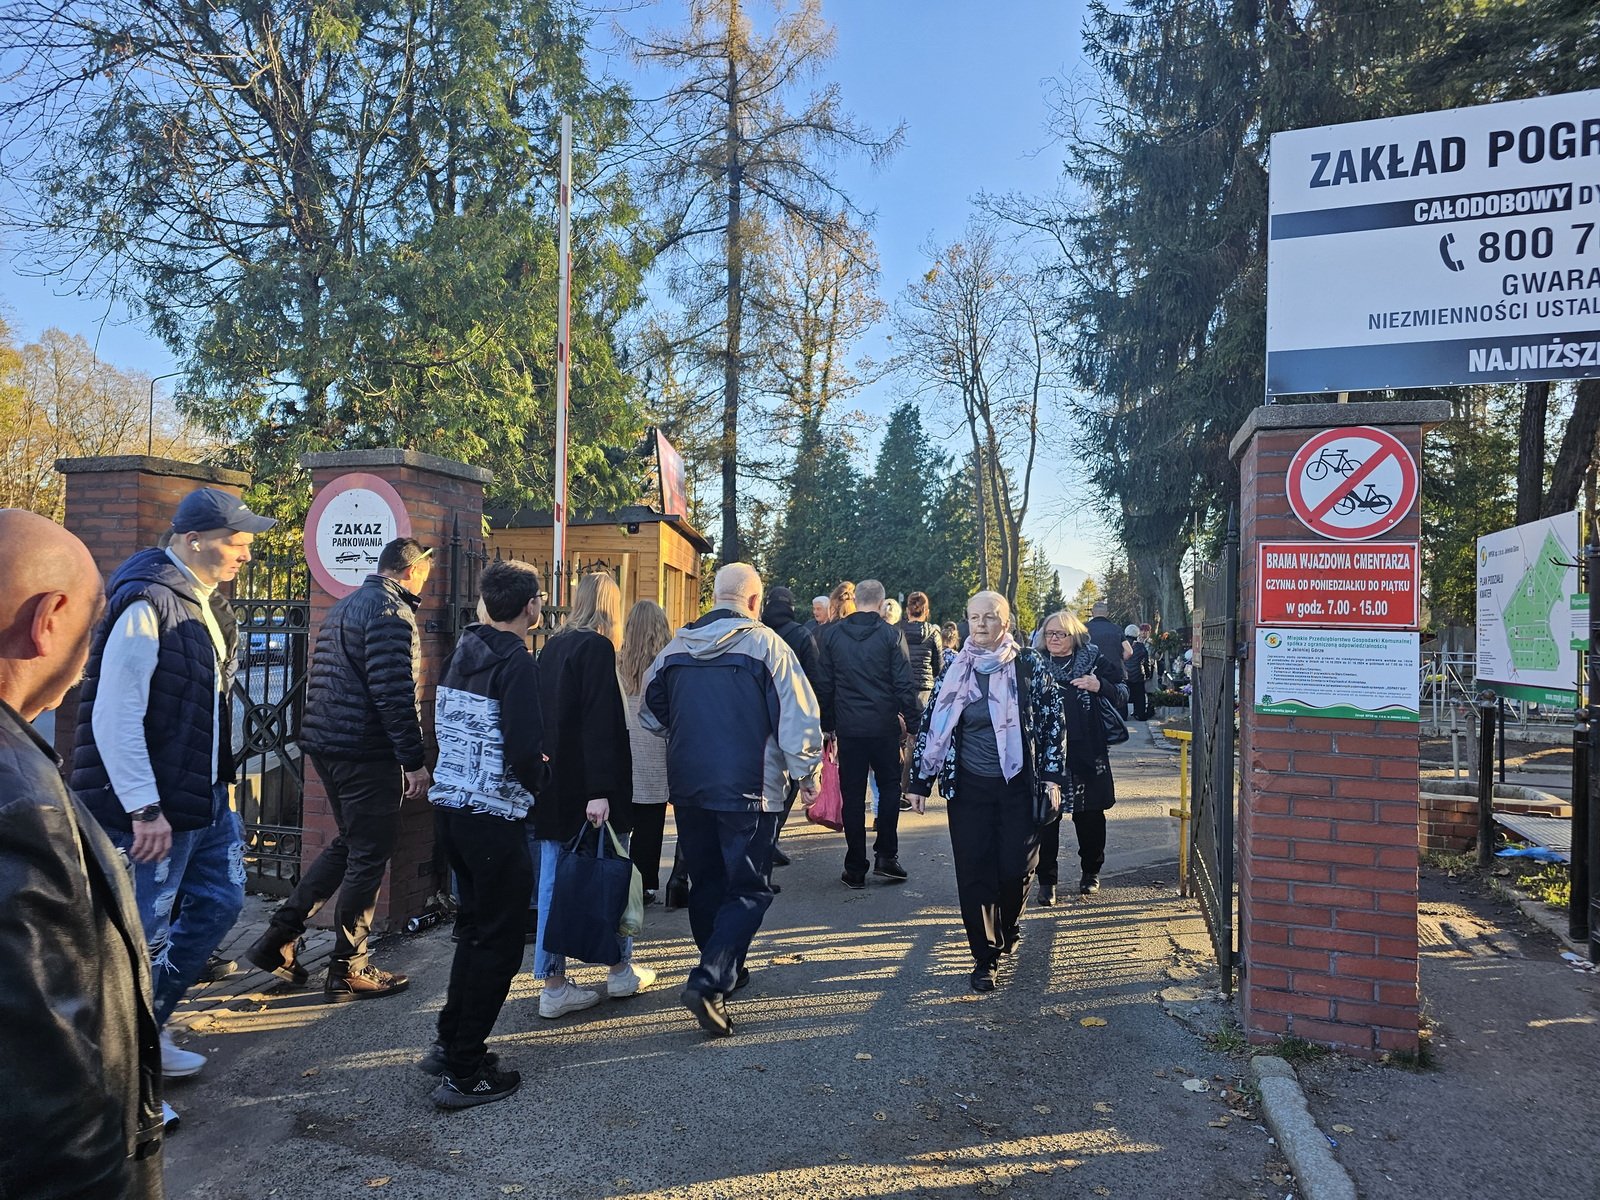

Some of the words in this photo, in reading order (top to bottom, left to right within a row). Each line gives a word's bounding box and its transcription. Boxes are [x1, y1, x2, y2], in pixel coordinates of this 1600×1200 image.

[1309, 136, 1467, 189] ZAKŁAD
[1488, 118, 1600, 168] POGR
[1414, 186, 1570, 222] CAŁODOBOWY
[1478, 226, 1554, 263] 800
[1571, 222, 1600, 255] 7
[1502, 267, 1600, 296] GWARA
[1368, 300, 1528, 330] NIEZMIENNOŚCI
[1536, 297, 1600, 318] USTAL
[1469, 337, 1600, 373] NAJNIŻSZ
[332, 537, 383, 547] PARKOWANIA
[334, 523, 382, 535] ZAKAZ
[1266, 553, 1298, 569] BRAMA
[1300, 553, 1351, 570] WJAZDOWA
[1353, 553, 1410, 570] CMENTARZA
[1265, 579, 1296, 590] CZYNNA
[1298, 579, 1309, 591] OD
[1310, 580, 1366, 591] PONIEDZIAŁKU
[1368, 580, 1379, 591] DO
[1381, 580, 1410, 594] PIĄTKU
[1286, 602, 1295, 614] w
[1297, 600, 1325, 617] godz.
[1327, 600, 1350, 615] 7.00
[1359, 600, 1388, 616] 15.00
